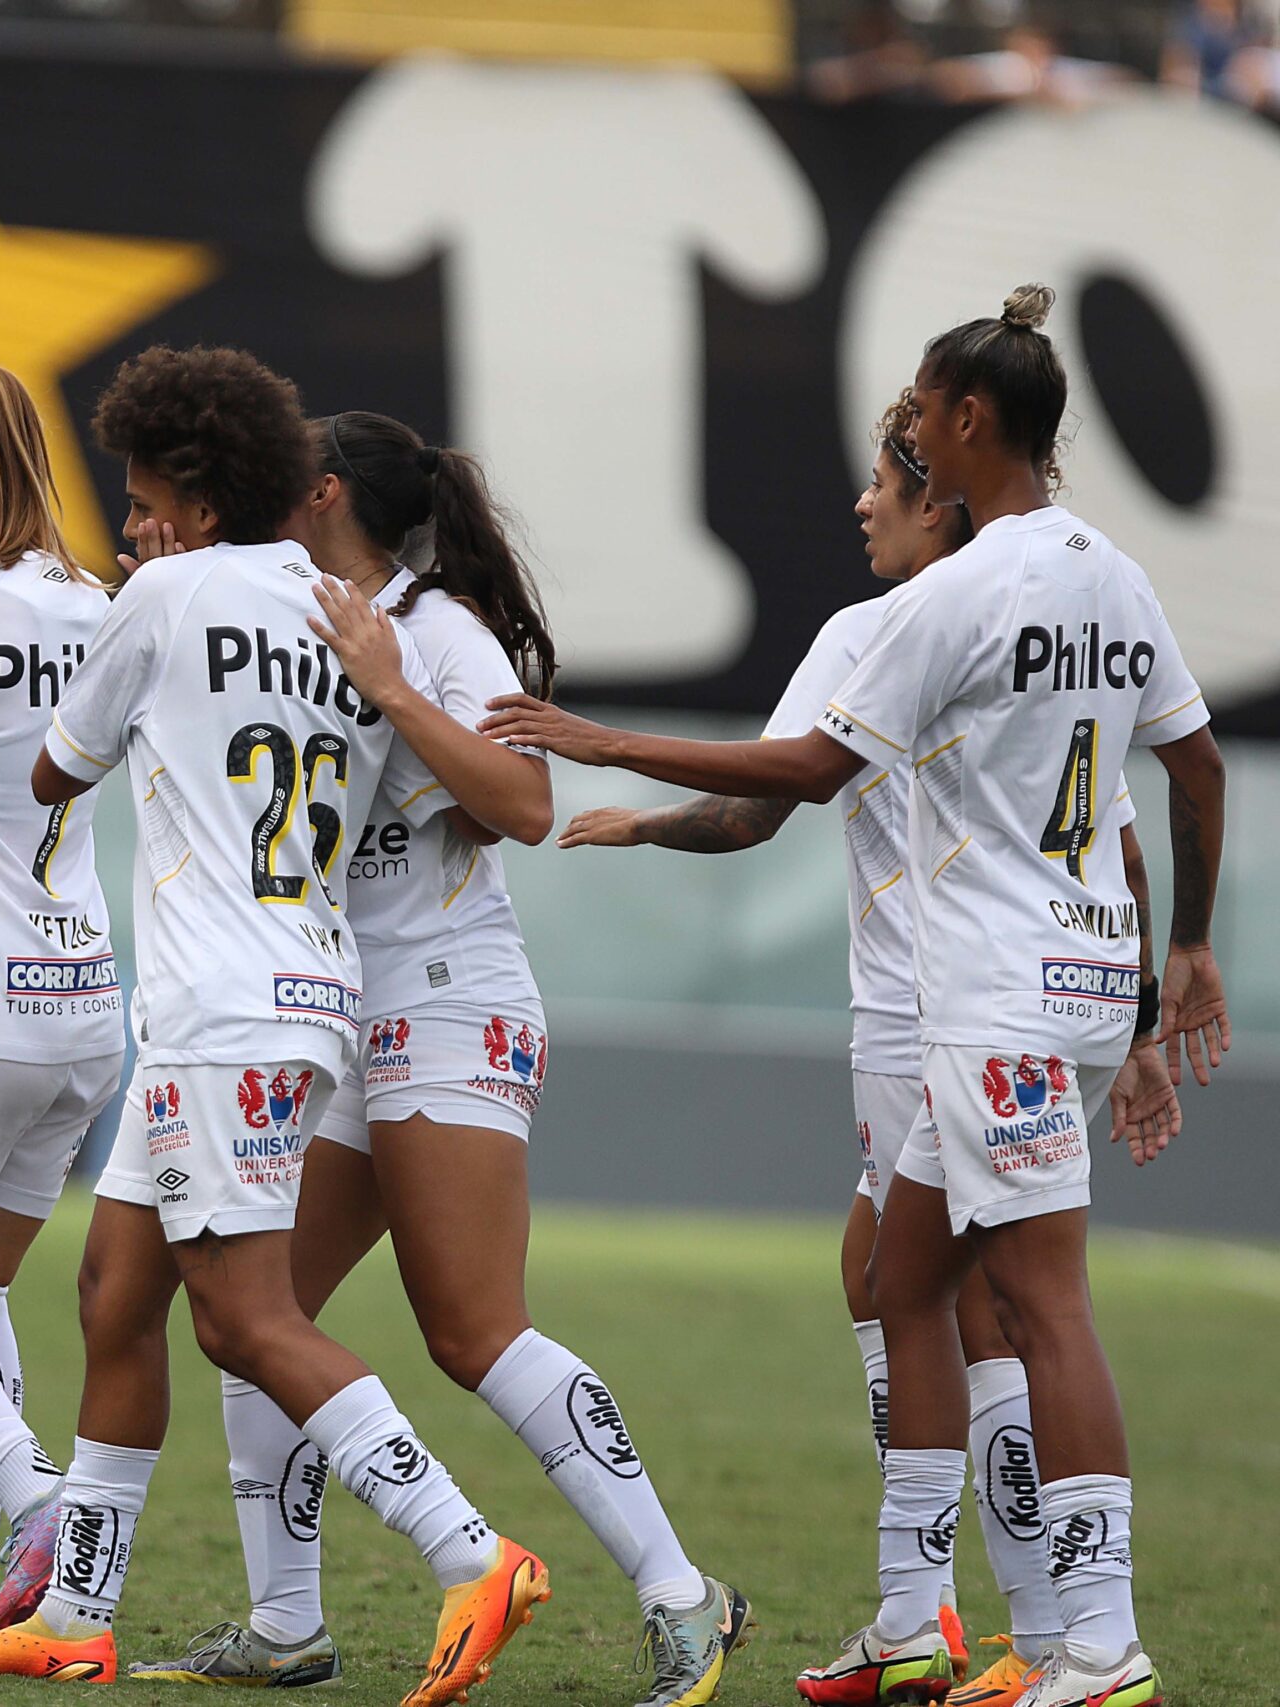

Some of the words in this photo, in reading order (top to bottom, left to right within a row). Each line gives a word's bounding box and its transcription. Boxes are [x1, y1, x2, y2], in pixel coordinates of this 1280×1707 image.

[1013, 622, 1156, 693] Philco
[227, 722, 349, 909] 26
[1040, 719, 1099, 887] 4
[1070, 828, 1083, 856] 2023
[10, 964, 76, 989] CORR
[1046, 964, 1104, 993] CORR
[6, 1000, 63, 1016] TUBOS
[72, 1002, 76, 1014] E
[277, 981, 341, 1011] CORR
[1041, 999, 1092, 1019] TUBOS
[1099, 1008, 1104, 1020] E
[370, 1055, 412, 1068] NISANTA
[380, 1073, 411, 1082] CECÍLIA
[147, 1120, 189, 1141] UNISANTA
[985, 1110, 1077, 1147] UNISANTA
[165, 1139, 191, 1153] CECÍLIA
[988, 1130, 1081, 1161] UNIVERSIDADE
[992, 1153, 1040, 1174] SANTA
[1045, 1143, 1084, 1164] CECÍLIA
[239, 1171, 281, 1184] SANTA
[161, 1192, 189, 1204] umbro
[581, 1380, 639, 1466] Kodilar
[291, 1447, 329, 1531] Kodila
[999, 1434, 1042, 1528] Kodilar
[62, 1504, 104, 1595] Kodilar
[114, 1542, 128, 1574] SFC
